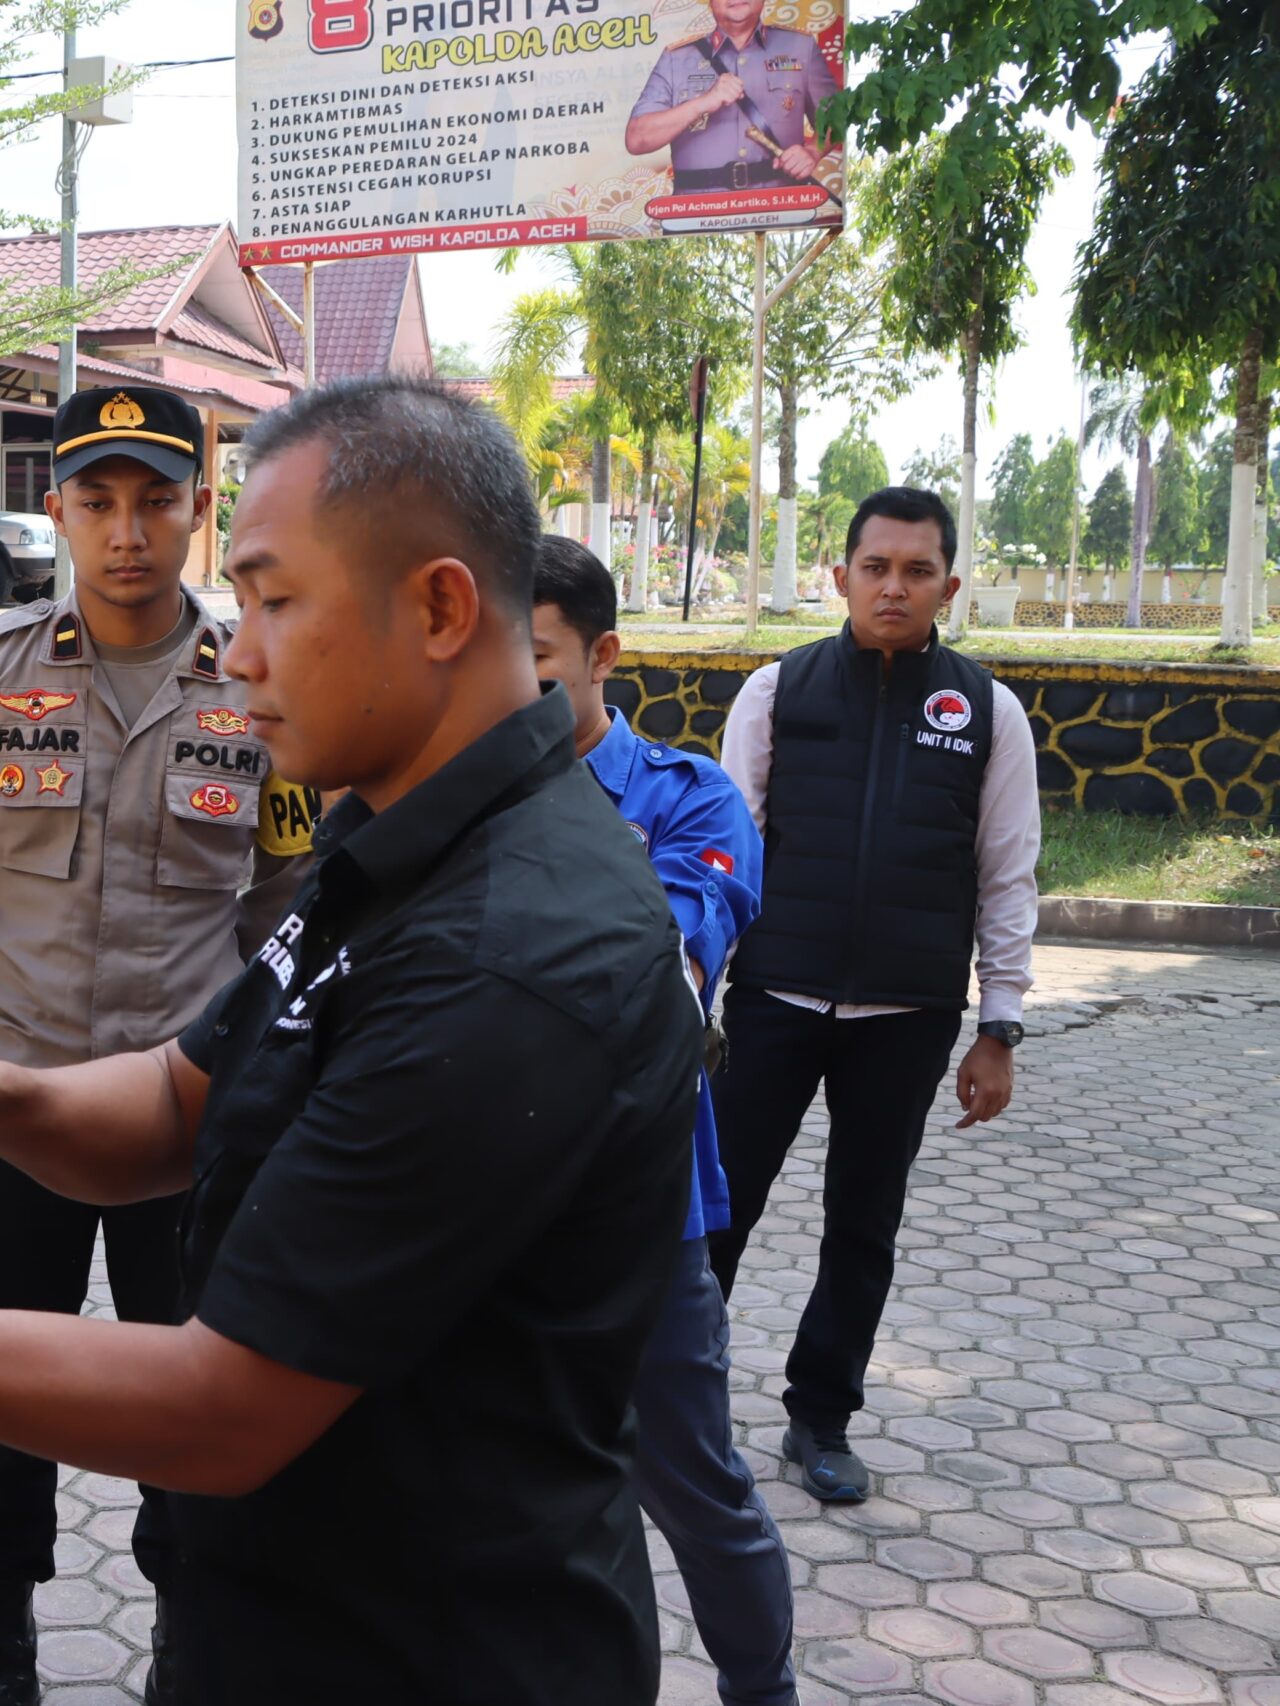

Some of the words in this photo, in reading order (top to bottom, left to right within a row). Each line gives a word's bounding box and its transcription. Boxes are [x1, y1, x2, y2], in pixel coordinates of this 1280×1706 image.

[382, 27, 548, 74] KAPOLDA
[553, 14, 658, 55] ACEH
[251, 101, 265, 112] 1.
[269, 92, 335, 111] DETEKSI
[340, 87, 376, 102] DINI
[380, 82, 415, 98] DAN
[420, 75, 490, 94] DETEKSI
[495, 70, 535, 86] AKSI
[251, 119, 265, 130] 2.
[269, 102, 403, 129] HARKAMTIBMAS
[251, 137, 265, 148] 3.
[269, 128, 339, 147] DUKUNG
[343, 117, 442, 138] PEMULIHAN
[446, 108, 527, 128] EKONOMI
[532, 101, 605, 120] DAERAH
[251, 155, 266, 166] 4.
[270, 143, 365, 164] SUKSESKAN
[370, 136, 432, 153] PEMILU
[436, 133, 478, 147] 2024
[252, 173, 266, 184] 5.
[270, 164, 338, 182] UNGKAP
[342, 154, 441, 174] PEREDARAN
[446, 149, 501, 165] GELAP
[505, 141, 591, 160] NARKOBA
[252, 190, 266, 201] 6.
[270, 181, 353, 200] ASISTENSI
[358, 176, 412, 192] CEGAH
[418, 168, 492, 187] KORUPSI
[252, 209, 266, 220] 7.
[270, 204, 309, 218] ASTA
[314, 199, 351, 214] SIAP
[252, 226, 267, 238] 8.
[271, 211, 430, 236] PENANGGULANGAN
[435, 203, 527, 222] KARHUTLA
[648, 205, 670, 215] Irjen
[672, 203, 687, 212] Pol
[689, 200, 728, 211] Achmad
[700, 217, 749, 228] KAPOLDA
[751, 215, 780, 226] ACEH
[280, 238, 383, 258] COMMANDER
[390, 233, 434, 249] WISH
[440, 228, 520, 246] KAPOLDA
[528, 223, 576, 240] ACEH
[175, 740, 260, 774] POLRI
[916, 730, 943, 747] UNIT
[953, 738, 974, 755] IDIK
